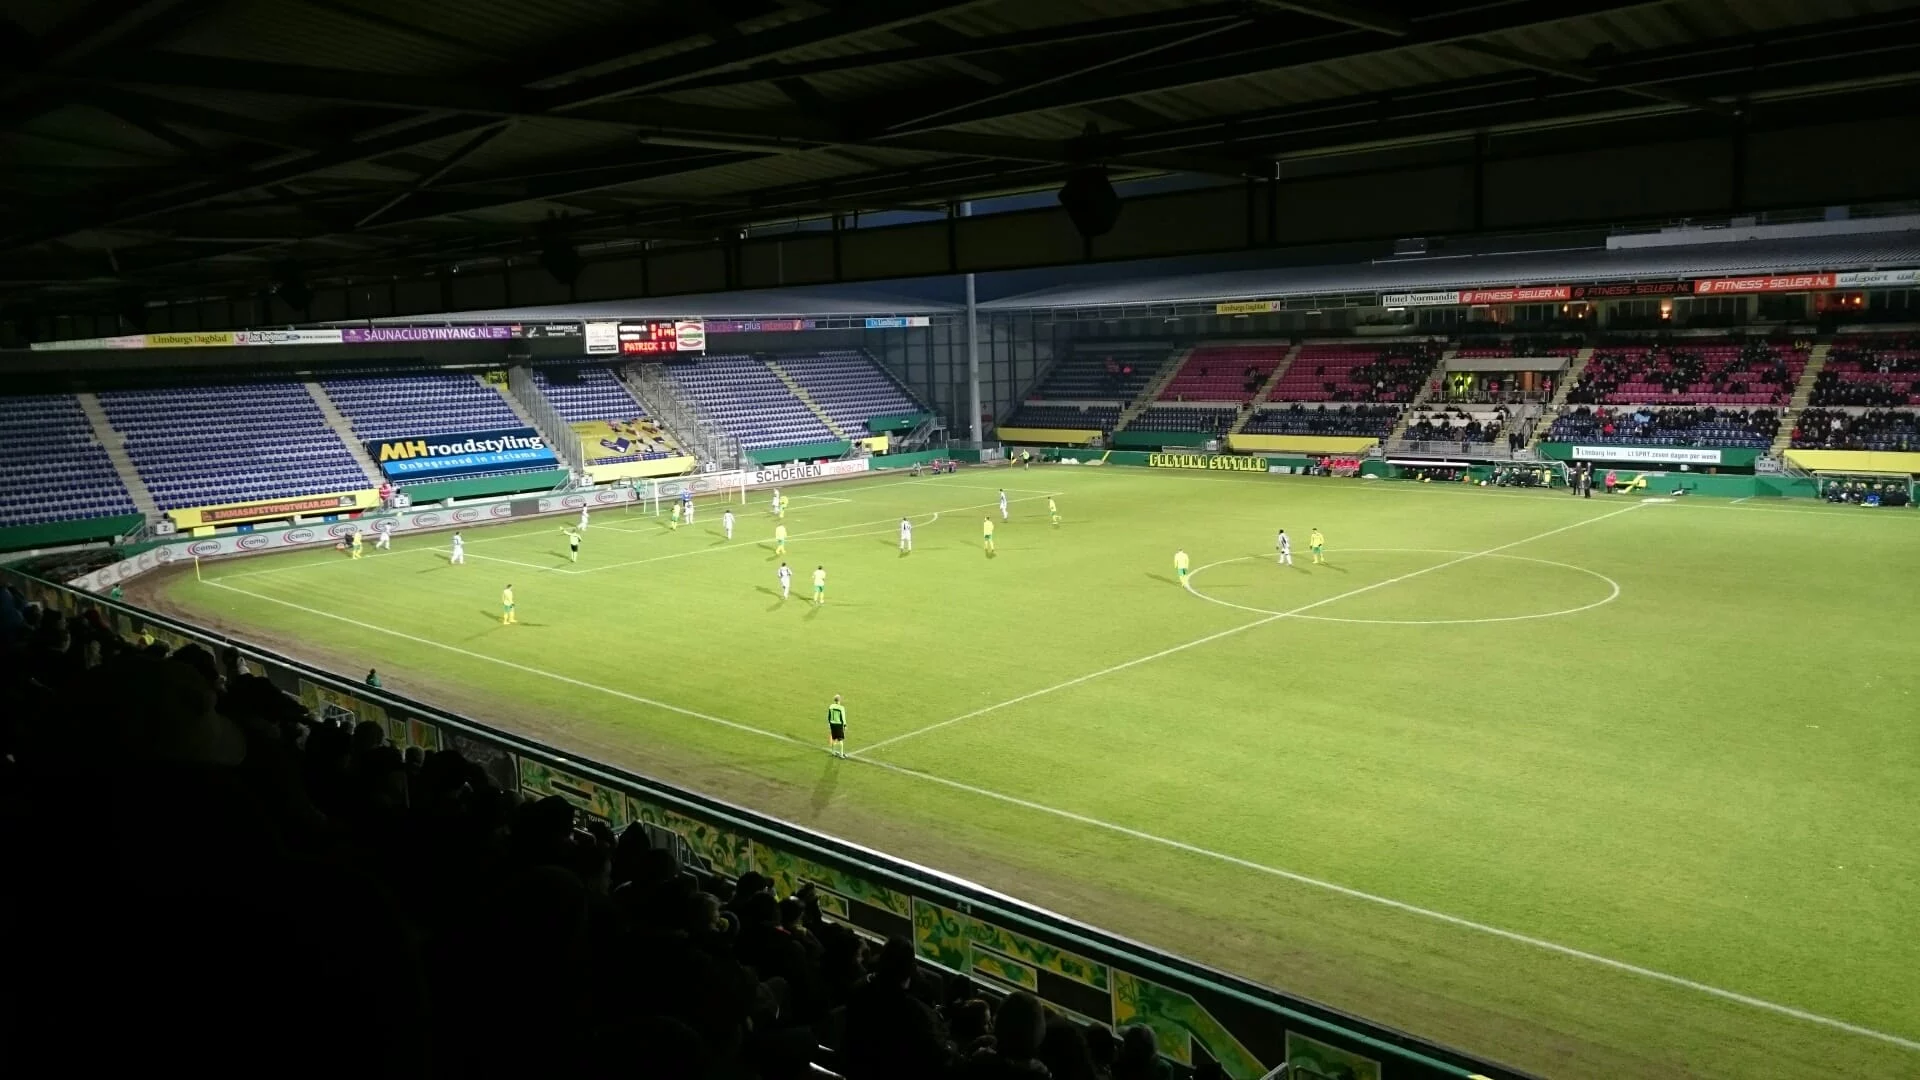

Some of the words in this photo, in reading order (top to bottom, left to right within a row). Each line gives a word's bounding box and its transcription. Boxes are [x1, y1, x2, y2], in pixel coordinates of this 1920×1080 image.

[1714, 276, 1831, 290] FITNESS-SELLER.NL
[1474, 289, 1568, 301] FITNESS-SELLER.NL
[1587, 283, 1690, 296] FITNESS-SELLER.NL
[1385, 295, 1408, 303] Hotel
[1410, 293, 1457, 302] Normandie
[744, 321, 761, 332] plus
[152, 335, 193, 345] Limburgs
[194, 333, 227, 345] Dagblad
[364, 327, 491, 341] SAUNACLUBYINYANG.NL
[624, 342, 658, 352] PATRICK
[476, 454, 488, 463] in
[1150, 453, 1207, 469] FORTUNA
[1209, 455, 1268, 472] SITTARD
[756, 465, 822, 484] SCHOENEN
[215, 498, 339, 519] EMMASAFETYFOOTWEAR.COM
